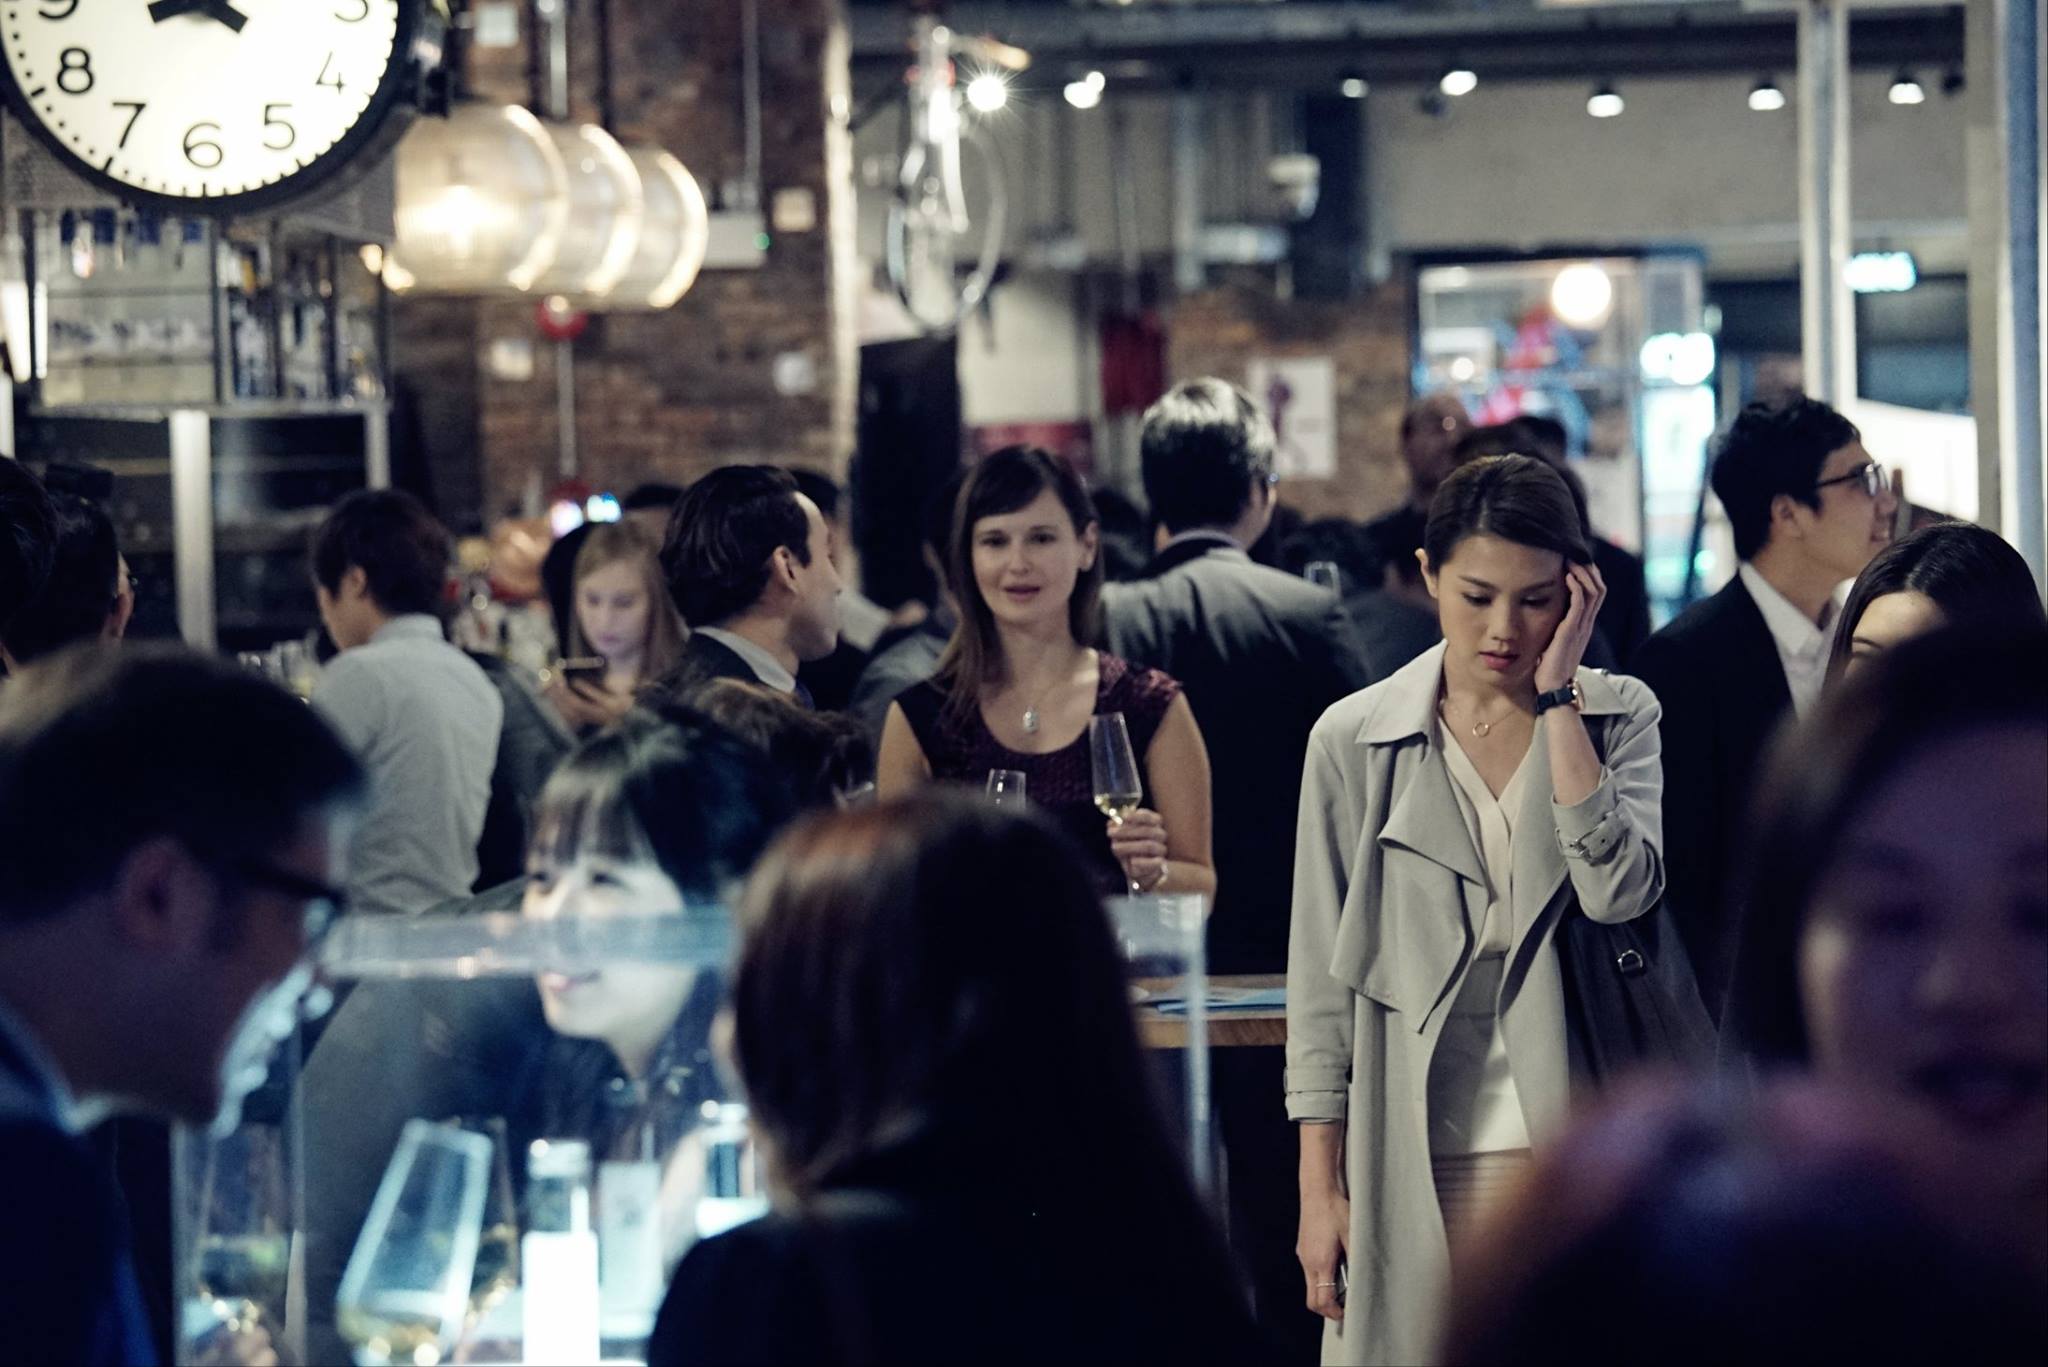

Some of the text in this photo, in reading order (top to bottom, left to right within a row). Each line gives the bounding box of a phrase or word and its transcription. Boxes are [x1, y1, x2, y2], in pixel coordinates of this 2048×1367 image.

[56, 47, 95, 95] 8
[315, 51, 346, 94] 4
[112, 101, 147, 149] 7
[182, 121, 223, 169] 6
[263, 103, 296, 151] 5
